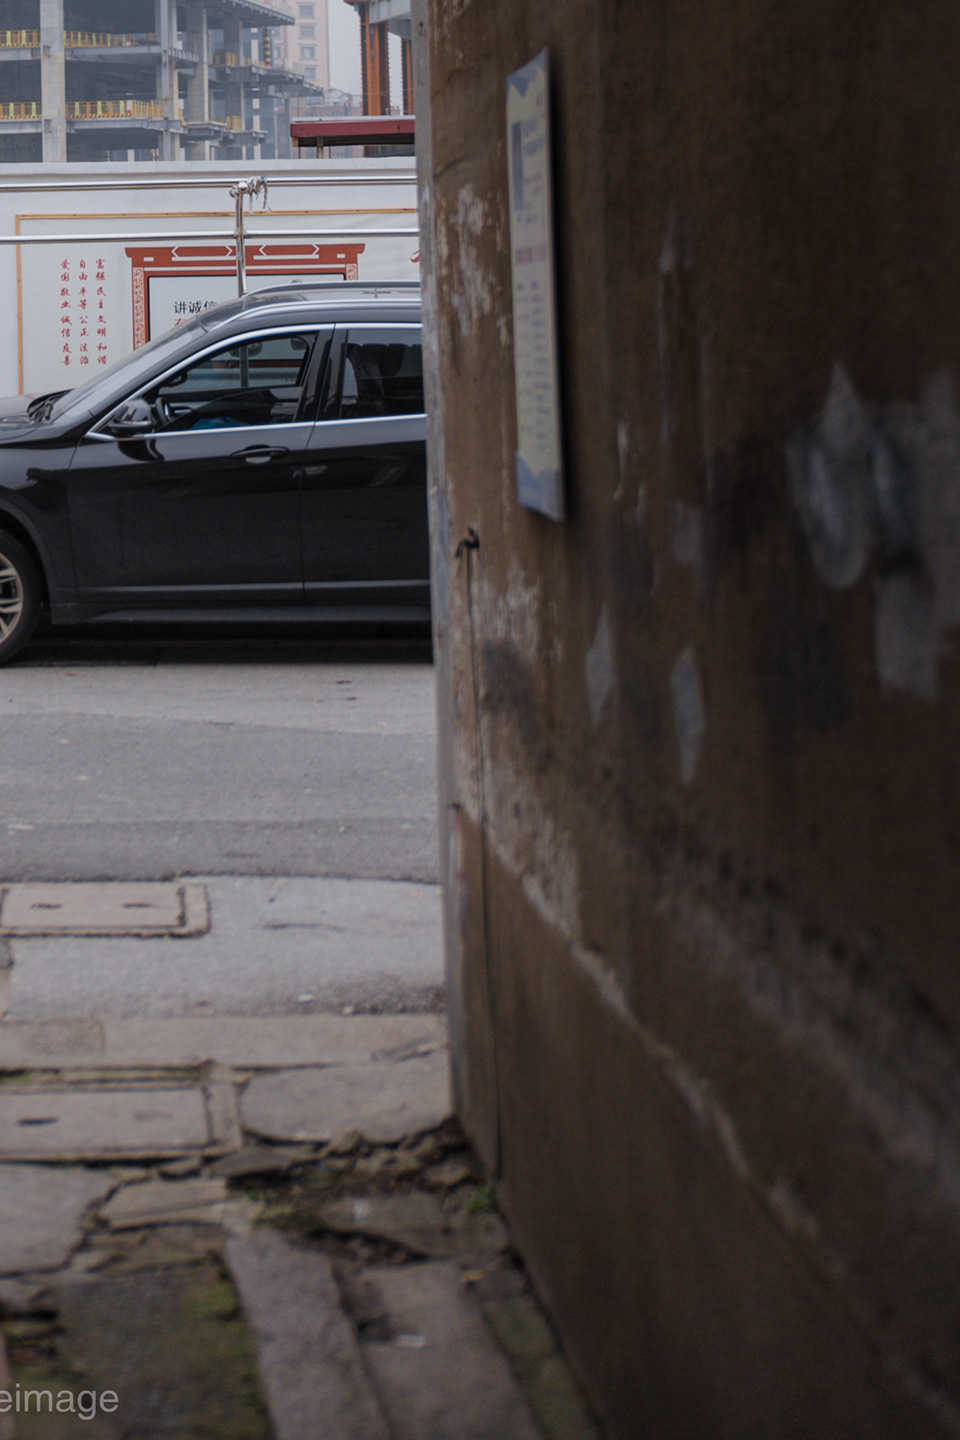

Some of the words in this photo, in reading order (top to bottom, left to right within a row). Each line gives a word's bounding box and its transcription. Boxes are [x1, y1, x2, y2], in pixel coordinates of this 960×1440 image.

[60, 258, 72, 367] 爱国敬业诚信友善
[78, 259, 90, 365] 自由平等公正法治
[95, 258, 107, 365] 富强民主文明和谐
